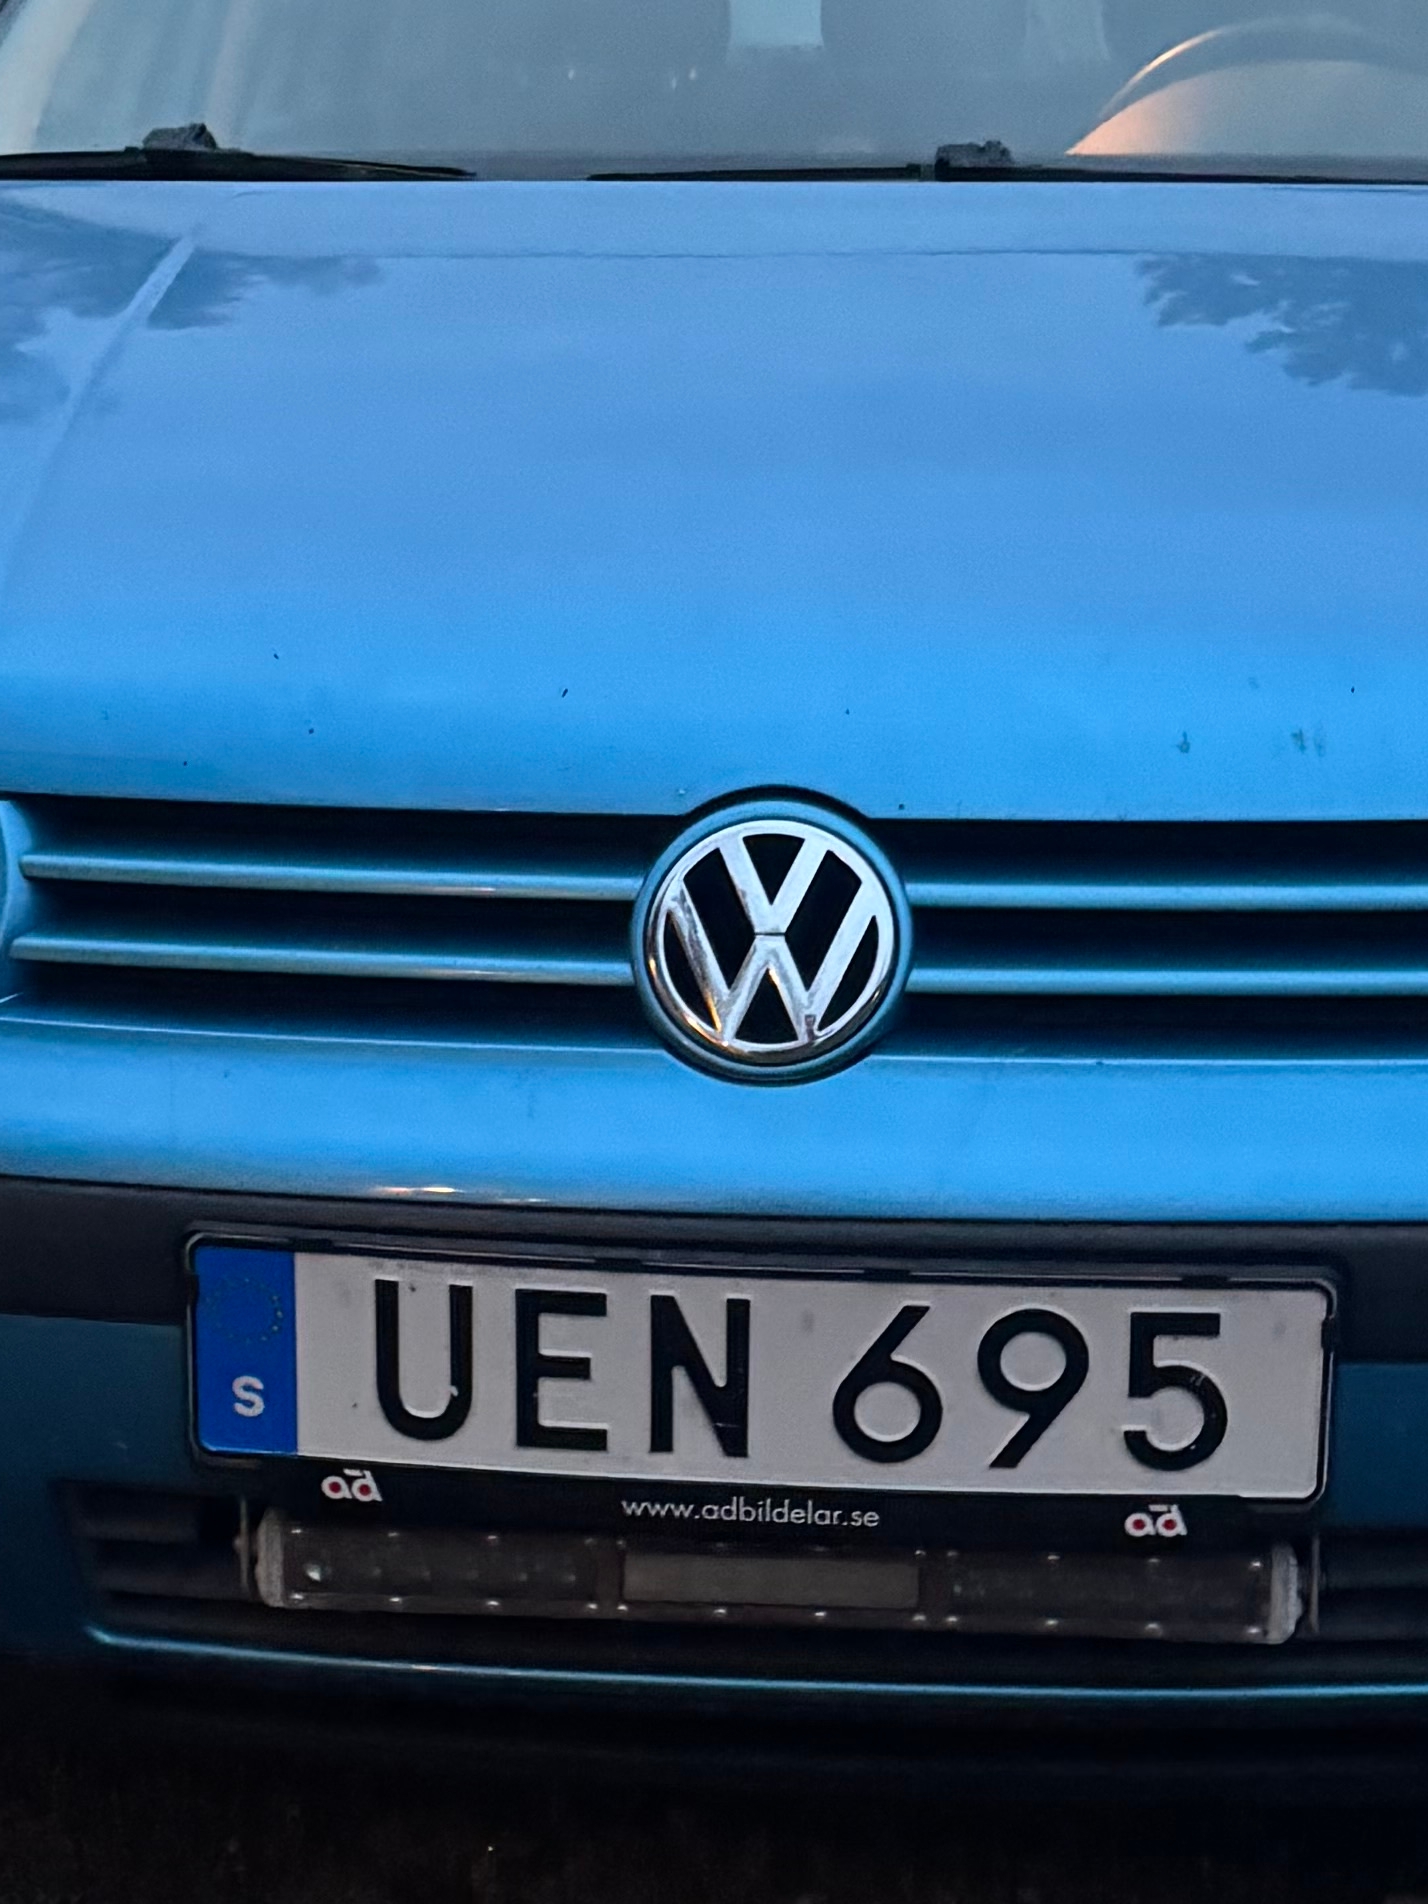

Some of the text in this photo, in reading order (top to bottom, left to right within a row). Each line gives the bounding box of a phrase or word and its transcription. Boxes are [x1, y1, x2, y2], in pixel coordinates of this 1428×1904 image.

[374, 1278, 1228, 1472] UEN 695
[232, 1376, 265, 1418] S
[621, 1496, 880, 1528] www.adbildelar.se
